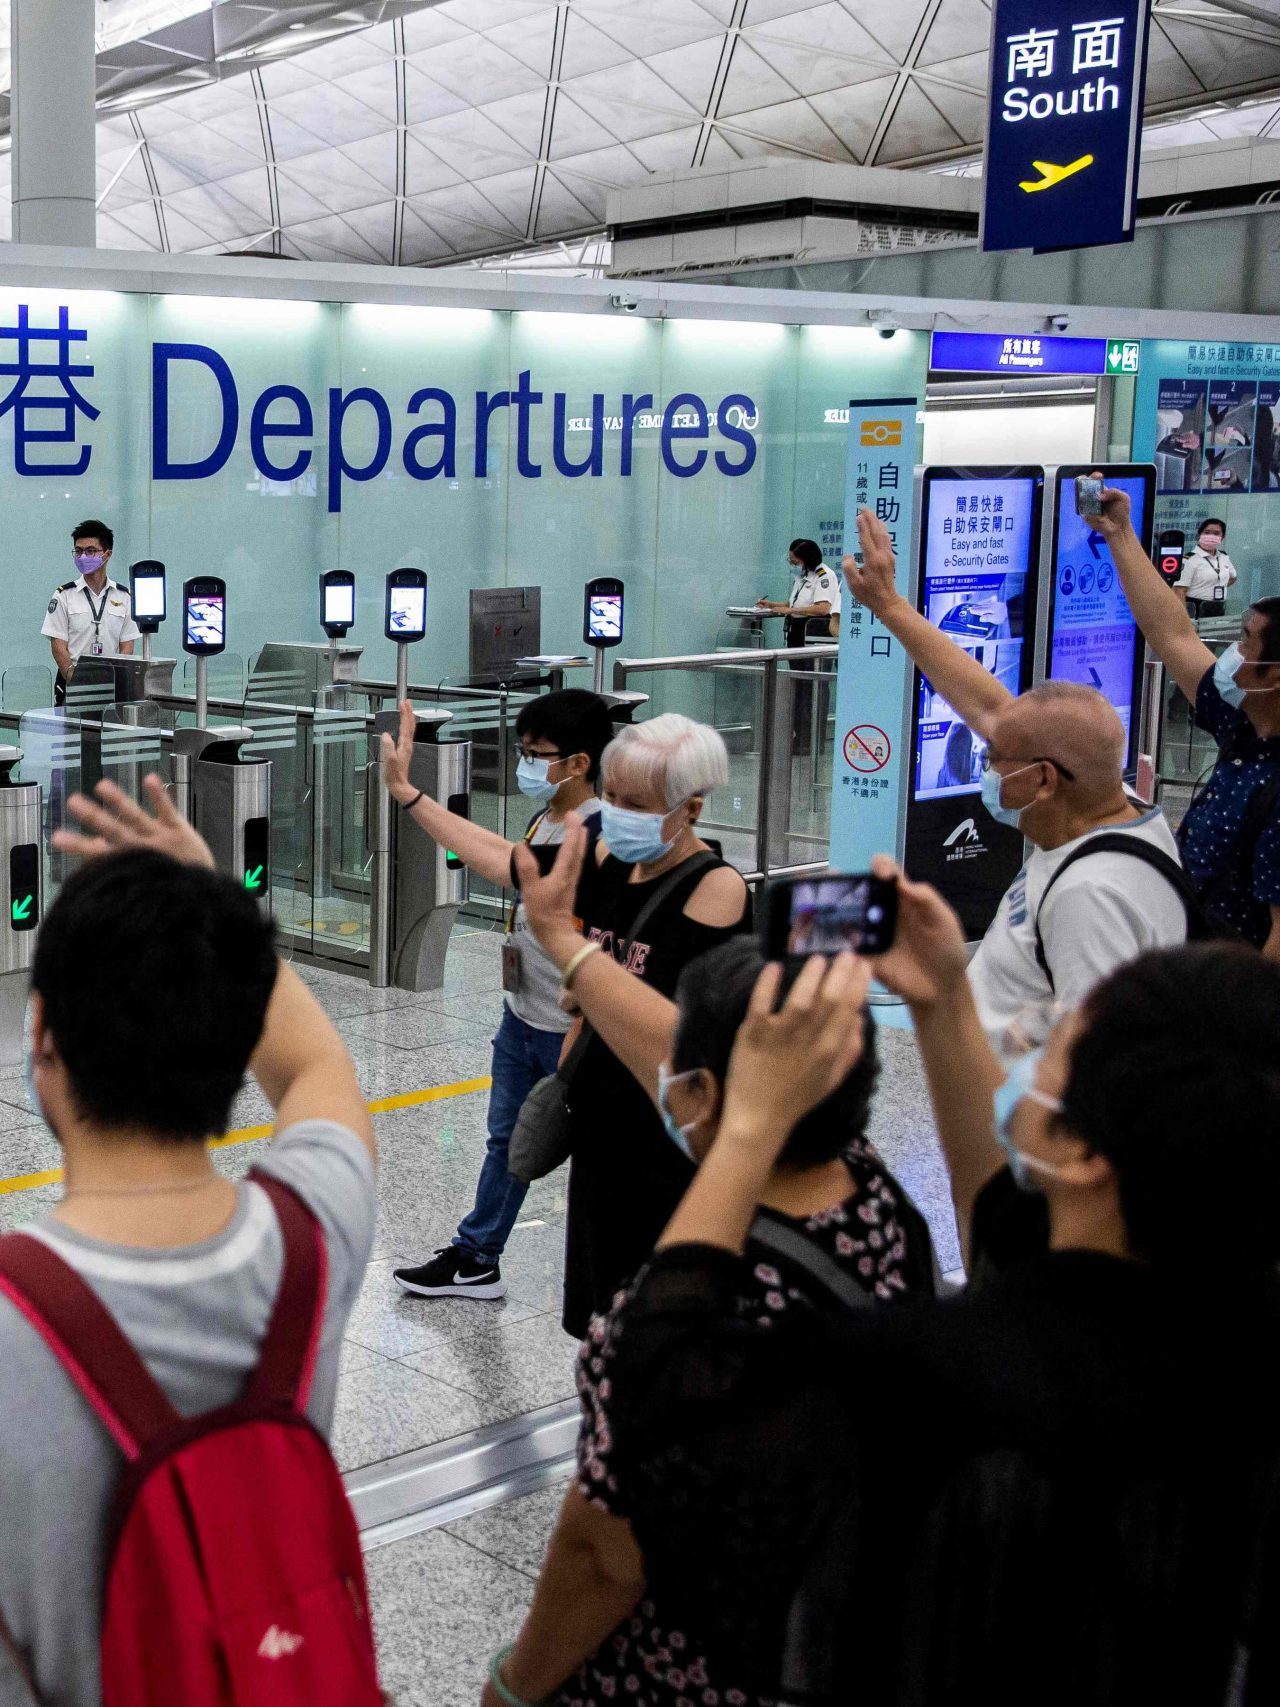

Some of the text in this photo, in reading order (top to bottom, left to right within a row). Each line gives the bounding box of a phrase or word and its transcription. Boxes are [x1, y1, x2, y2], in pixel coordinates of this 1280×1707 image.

[1006, 17, 1124, 82] 南面
[1002, 76, 1119, 122] South
[150, 342, 757, 512] Departures
[956, 495, 1004, 513] 簡易快捷
[943, 515, 1014, 534] 自助保安閘口
[951, 537, 1004, 551] Easy and fast
[944, 553, 1009, 567] e-Security Gates
